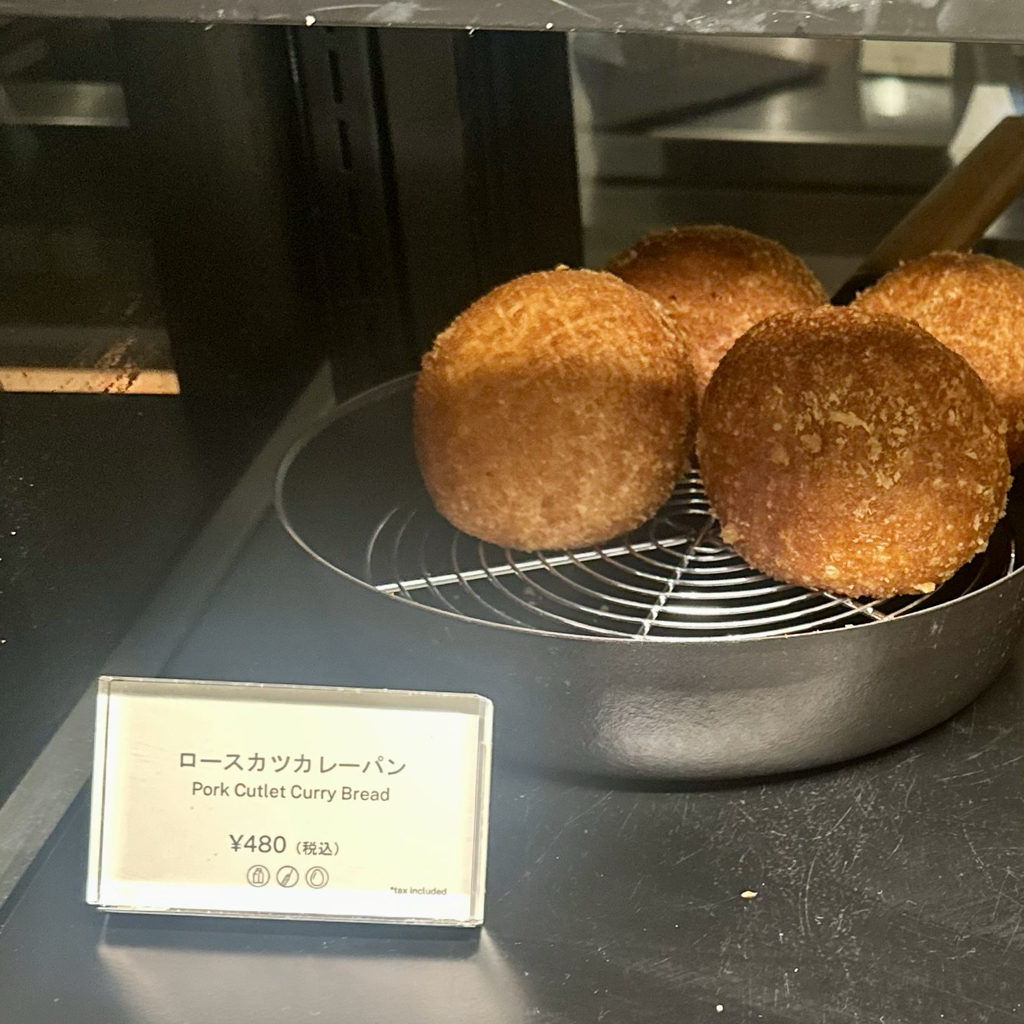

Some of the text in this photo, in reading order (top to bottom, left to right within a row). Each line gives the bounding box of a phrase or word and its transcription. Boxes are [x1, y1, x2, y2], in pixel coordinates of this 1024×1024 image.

[179, 752, 407, 776] ロースカツカレーパン
[191, 781, 391, 803] Pork Cutlet Curry Bread
[228, 834, 340, 857] ¥480 (税込)
[409, 886, 447, 896] included
